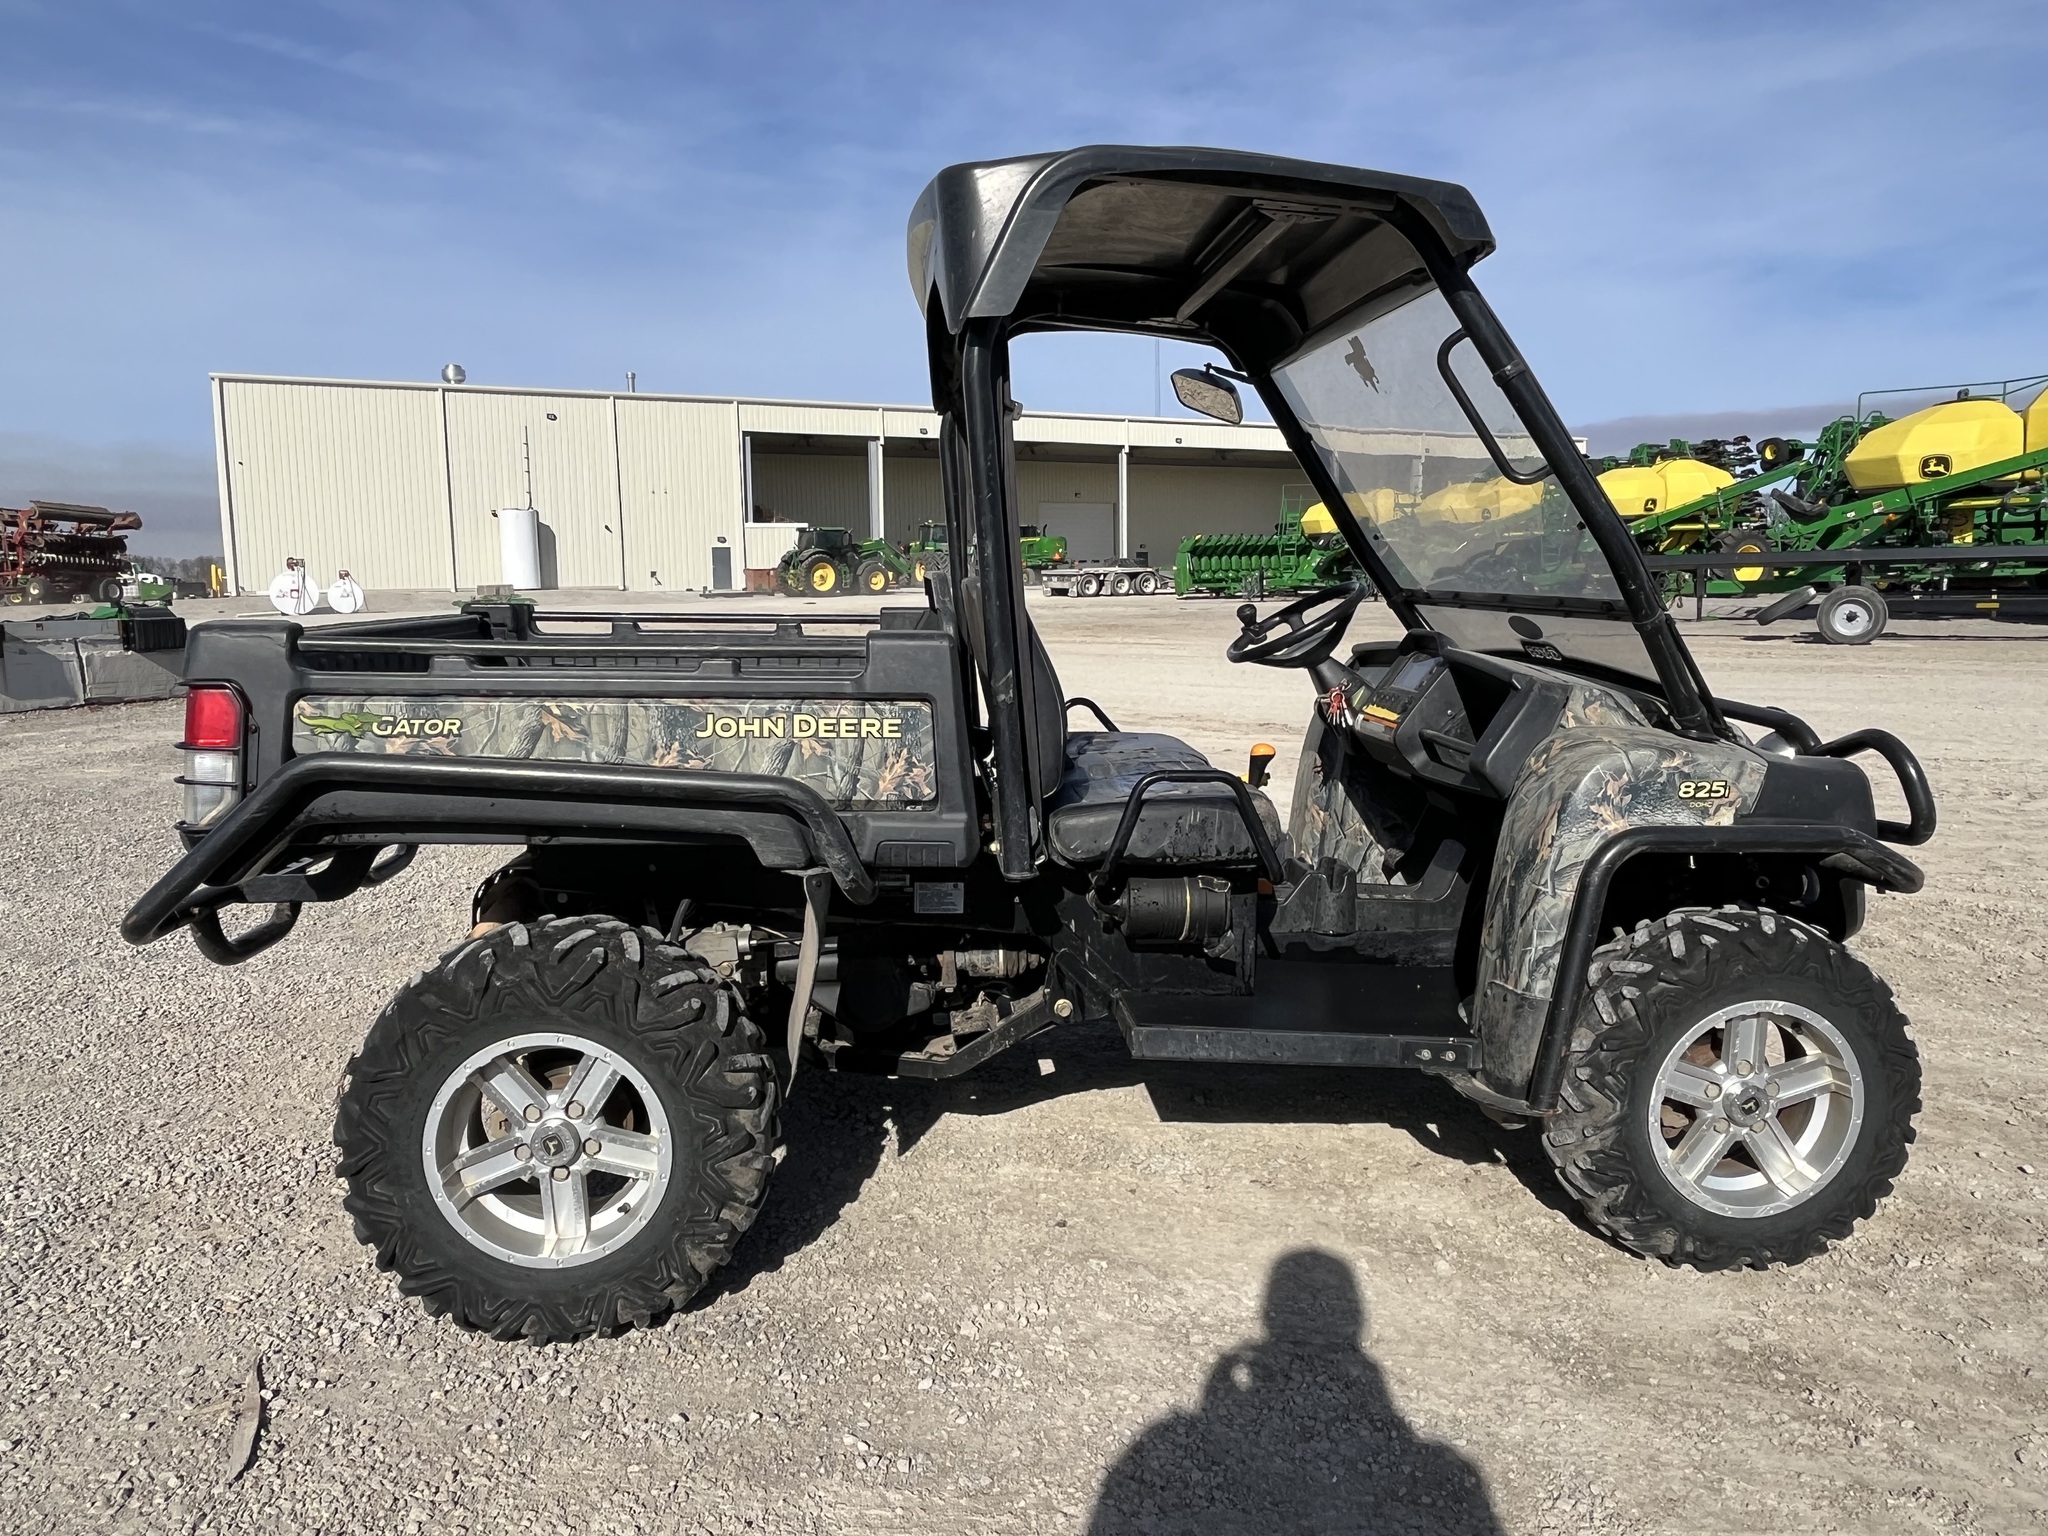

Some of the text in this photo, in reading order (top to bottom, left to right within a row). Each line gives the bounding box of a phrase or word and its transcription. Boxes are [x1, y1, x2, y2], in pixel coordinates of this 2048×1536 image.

[371, 716, 462, 737] GATOR
[695, 713, 903, 738] JOHN DEERE
